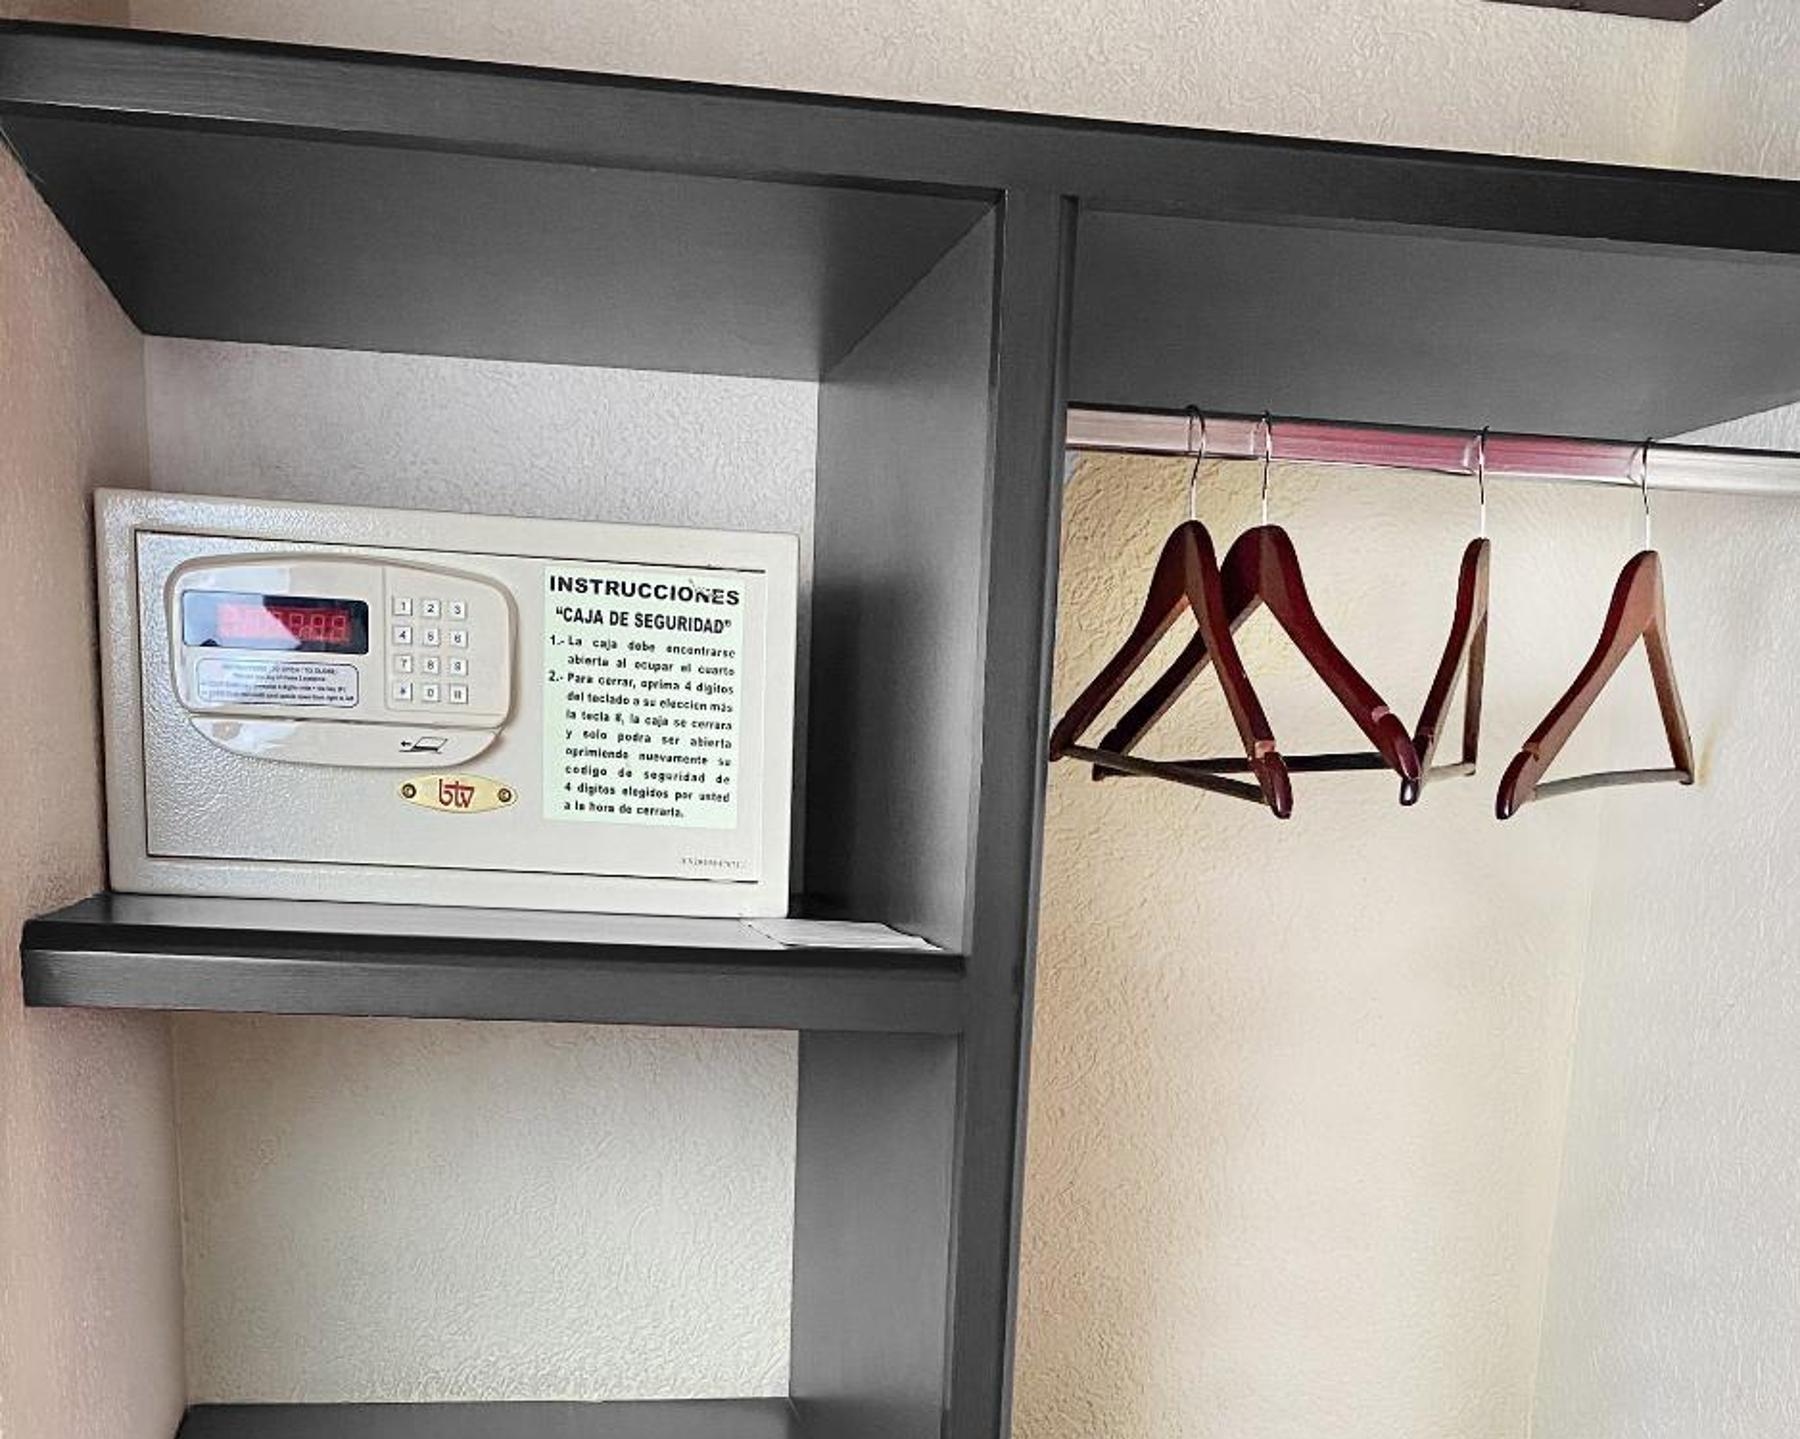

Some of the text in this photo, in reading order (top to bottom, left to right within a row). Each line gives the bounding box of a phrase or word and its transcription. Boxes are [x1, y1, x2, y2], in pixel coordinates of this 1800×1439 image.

[550, 575, 740, 605] INSTRUCCIONES
[609, 610, 629, 627] DE
[568, 636, 582, 646] La
[592, 638, 617, 651] caja
[627, 640, 655, 651] debe
[666, 644, 736, 658] encontrarse
[568, 654, 735, 676] abierta al ocupar el cuarto
[567, 672, 593, 684] Para
[641, 679, 680, 692] oprima
[684, 680, 691, 691] 4
[567, 691, 584, 702] del
[587, 692, 629, 705] teclado
[633, 698, 640, 706] a
[643, 698, 656, 707] su
[565, 709, 576, 719] la
[581, 711, 610, 722] tecla
[629, 713, 640, 724] la
[644, 716, 669, 728] caja
[673, 718, 686, 728] se
[565, 729, 572, 739] y
[583, 729, 607, 740] solo
[661, 736, 680, 746] ser
[690, 737, 732, 749] abierta
[565, 746, 731, 767] oprimiendo nuevamente su
[617, 767, 632, 778] de
[644, 770, 705, 783] seguridad
[715, 773, 730, 785] de
[439, 778, 474, 808] btv
[564, 781, 571, 791] 4
[621, 786, 668, 799] elegidos
[675, 790, 693, 802] por
[699, 792, 730, 803] usted
[564, 801, 571, 810] a
[575, 800, 585, 811] la
[588, 801, 615, 813] hora
[619, 803, 632, 814] de
